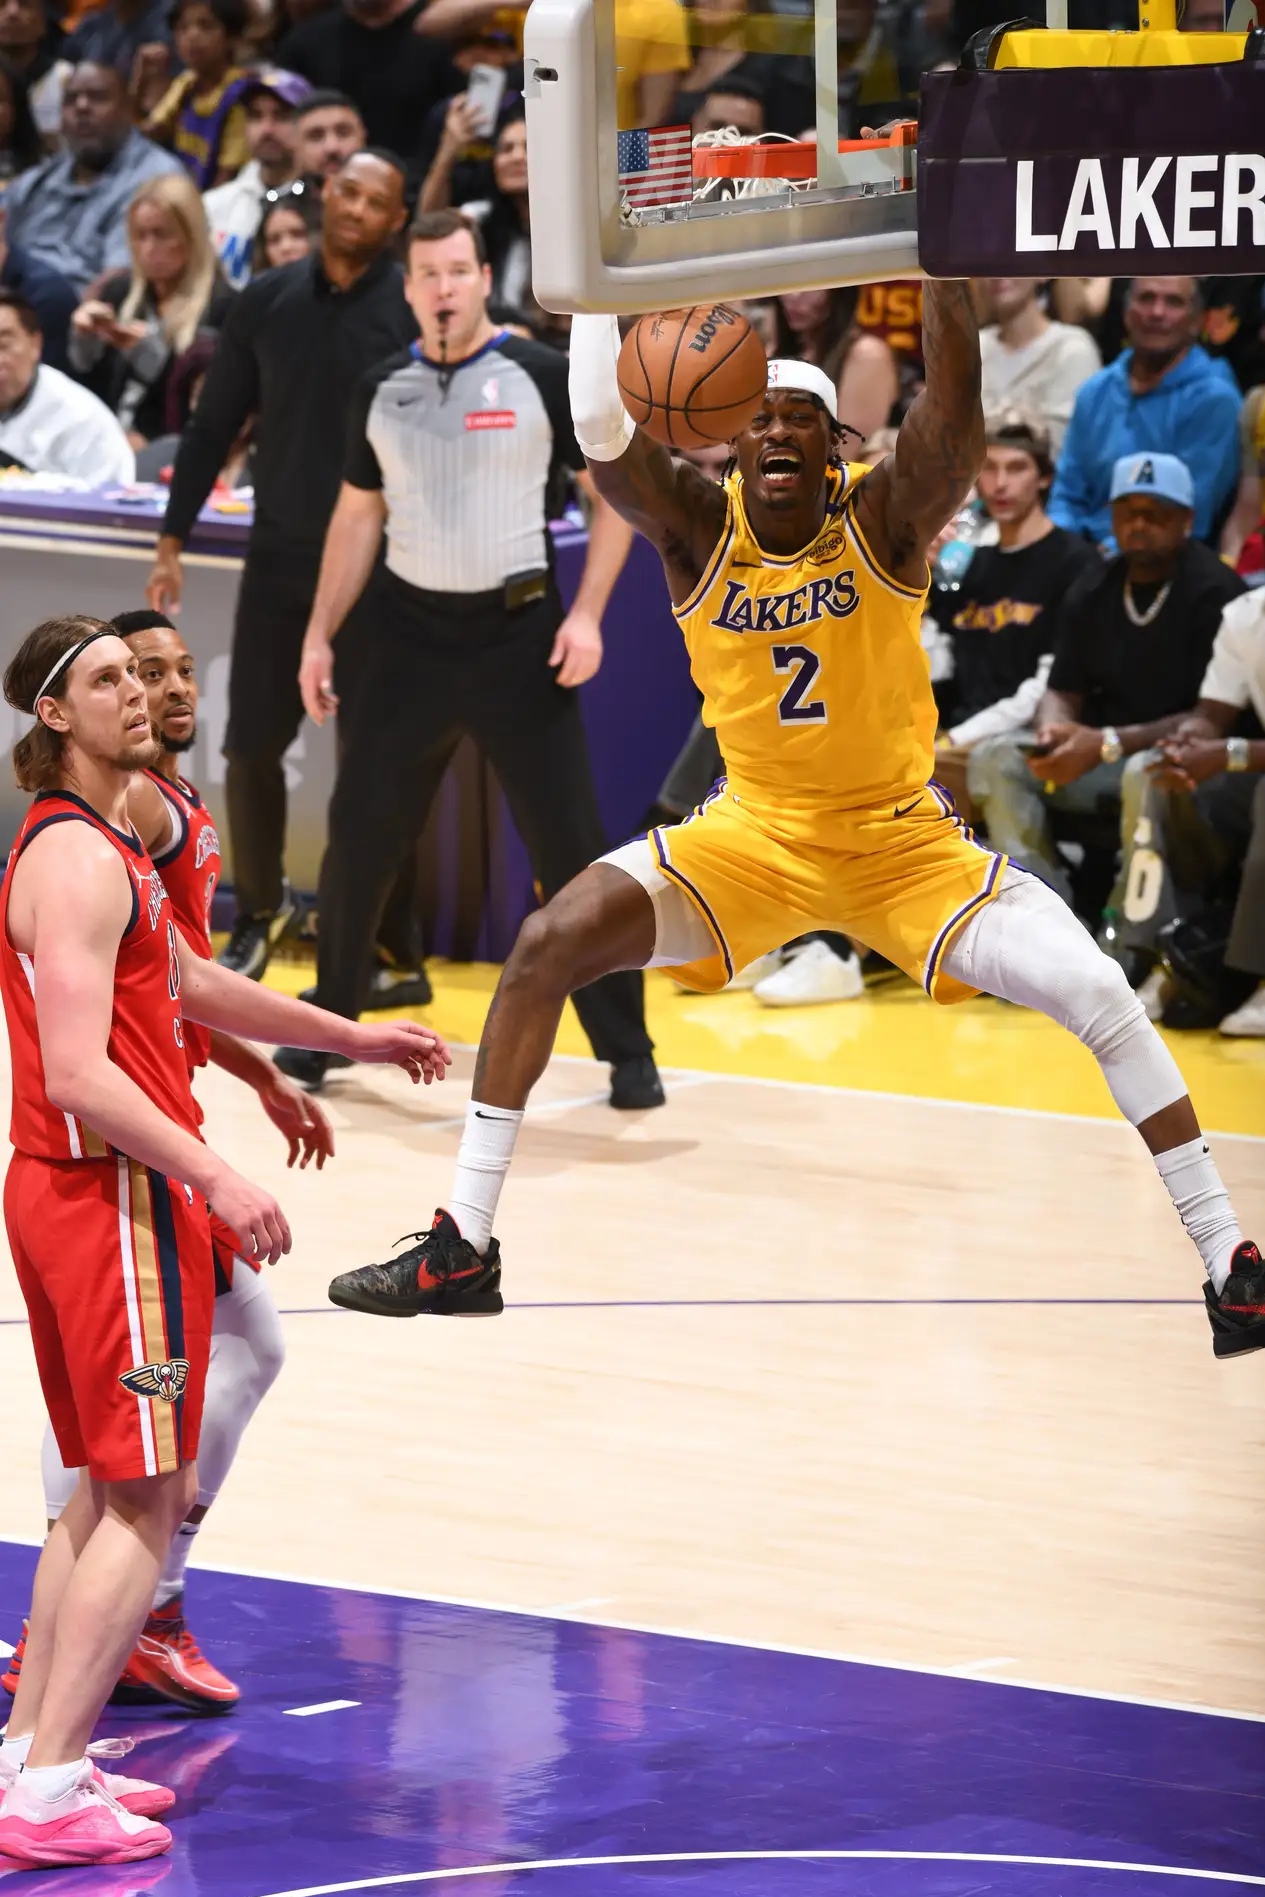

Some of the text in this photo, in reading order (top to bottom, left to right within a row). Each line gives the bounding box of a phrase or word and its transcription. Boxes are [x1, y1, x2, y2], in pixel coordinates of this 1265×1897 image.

[1015, 154, 1265, 252] LAKER
[856, 286, 923, 327] US
[709, 569, 860, 635] LAKERS
[770, 644, 828, 726] 2
